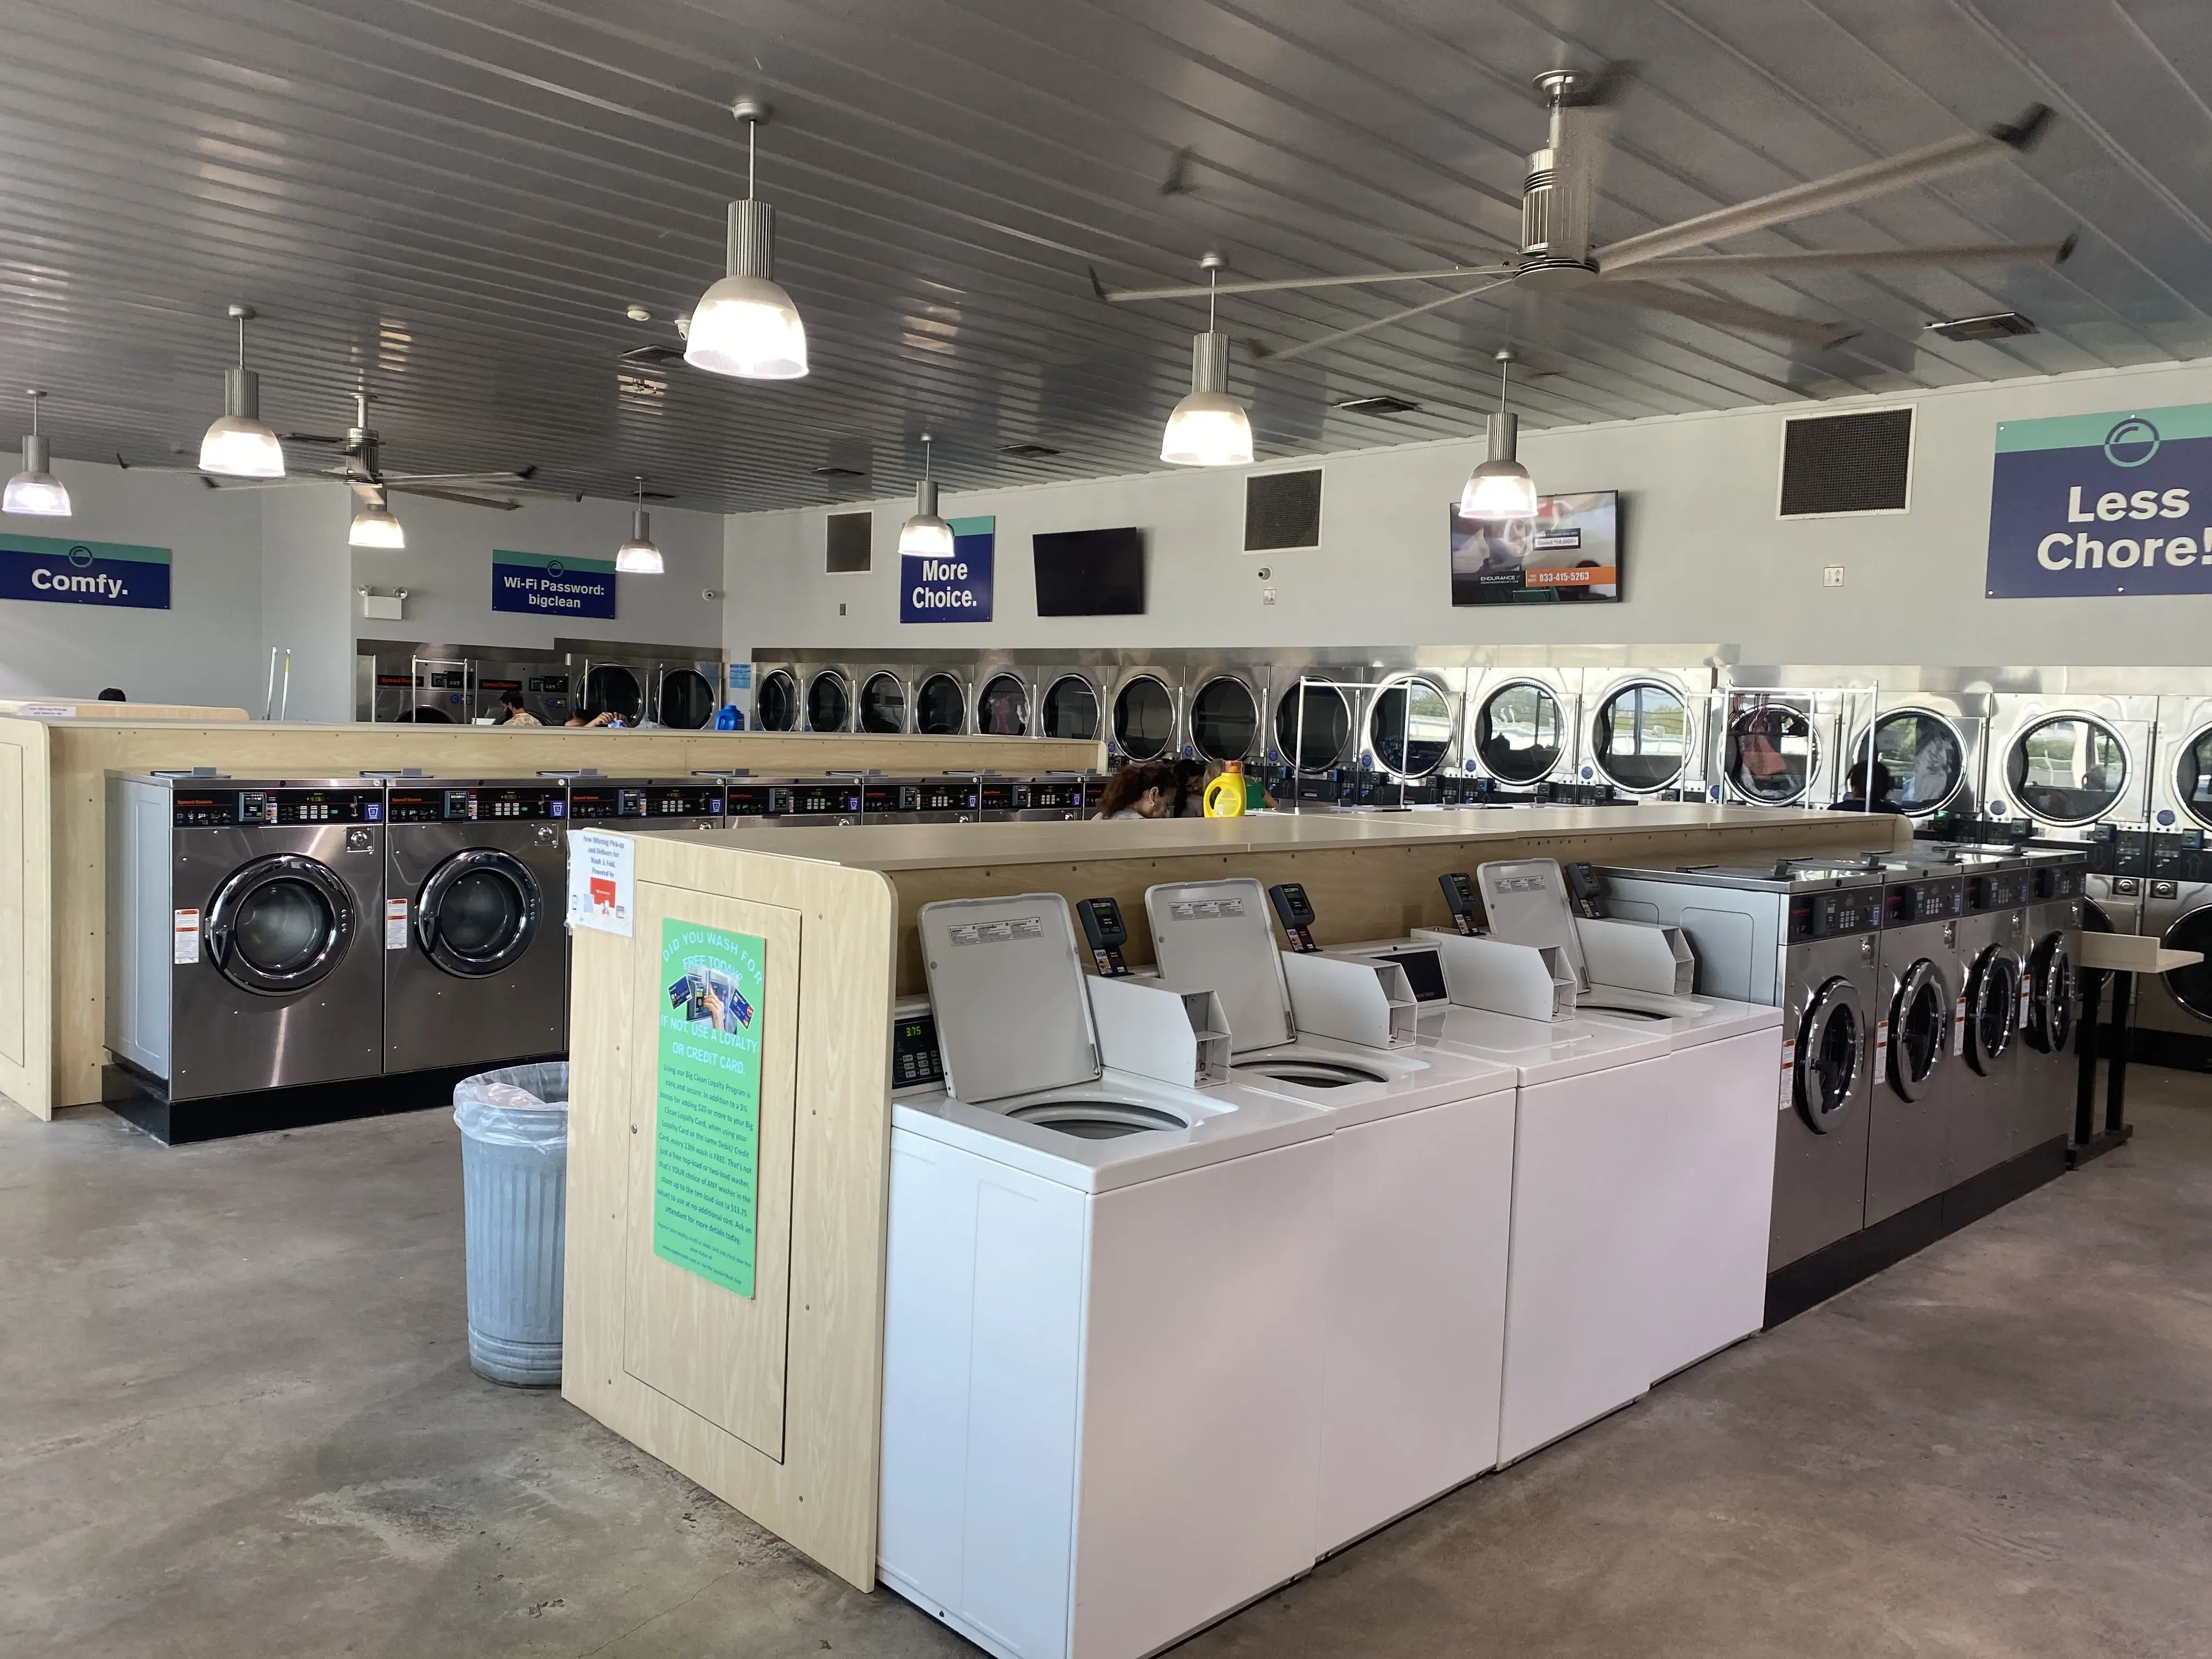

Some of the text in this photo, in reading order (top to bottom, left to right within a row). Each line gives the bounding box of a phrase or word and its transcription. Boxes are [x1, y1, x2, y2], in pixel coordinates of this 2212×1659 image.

[2068, 486, 2190, 523] Less
[2037, 527, 2212, 571] Chore!
[31, 568, 128, 599] Comfy.
[504, 575, 605, 597] Wi-Fi Password:
[922, 560, 968, 582] More
[1539, 572, 1589, 582] 833-415-5263
[528, 594, 582, 610] bigclean
[912, 586, 978, 610] Choice.
[592, 837, 609, 847] Offering
[610, 840, 624, 849] Pick-up
[596, 848, 612, 857] Delivery
[590, 857, 601, 865] Wash
[592, 867, 614, 878] Powered by
[662, 931, 762, 985] DID YOU WASH FOR
[683, 954, 706, 970] FREE
[661, 1014, 669, 1027] IF
[692, 1024, 708, 1039] USE
[711, 1029, 716, 1041] A
[719, 1032, 758, 1053] LOYALTY
[673, 1041, 746, 1075] OR CREDIT CARD.
[663, 1063, 676, 1075] Using
[693, 1073, 707, 1083] Clean
[707, 1078, 724, 1090] Loyalty
[725, 1084, 745, 1096] Program
[659, 1091, 673, 1101] bonus
[681, 1099, 697, 1111] adding
[697, 1103, 707, 1113] $20
[713, 1111, 726, 1120] more
[665, 1080, 675, 1088] easy
[703, 1091, 708, 1099] In
[709, 1094, 729, 1105] addition
[740, 1103, 747, 1113] 5%
[661, 1119, 678, 1132] Loyalty
[678, 1125, 689, 1135] Card
[695, 1132, 704, 1141] the
[704, 1137, 717, 1146] same
[734, 1147, 749, 1158] Credit
[664, 1106, 747, 1142] Clean Loyalty Card, when using your
[658, 1132, 670, 1143] Card,
[670, 1138, 683, 1149] every
[684, 1142, 695, 1152] 13th
[696, 1148, 708, 1156] wash
[708, 1150, 713, 1159] is
[727, 1158, 742, 1170] That's
[743, 1166, 752, 1174] not
[659, 1147, 668, 1156] just
[672, 1151, 681, 1161] free
[682, 1156, 702, 1169] top-load
[709, 1166, 730, 1180] two-load
[658, 1160, 671, 1171] that's
[672, 1165, 685, 1176] YOUR
[685, 1172, 700, 1183] choice
[707, 1180, 717, 1189] ANY
[718, 1186, 735, 1197] washer
[742, 1194, 751, 1204] the
[661, 1176, 672, 1186] store
[685, 1186, 693, 1194] the
[694, 1189, 714, 1203] ten-load
[714, 1198, 724, 1207] size
[724, 1201, 730, 1210] (a
[730, 1204, 747, 1217] $13.75
[656, 1188, 670, 1200] value)
[698, 1206, 722, 1221] additional
[735, 1221, 744, 1231] Ask
[665, 1206, 687, 1220] attendant
[695, 1220, 708, 1229] more
[708, 1224, 725, 1237] details
